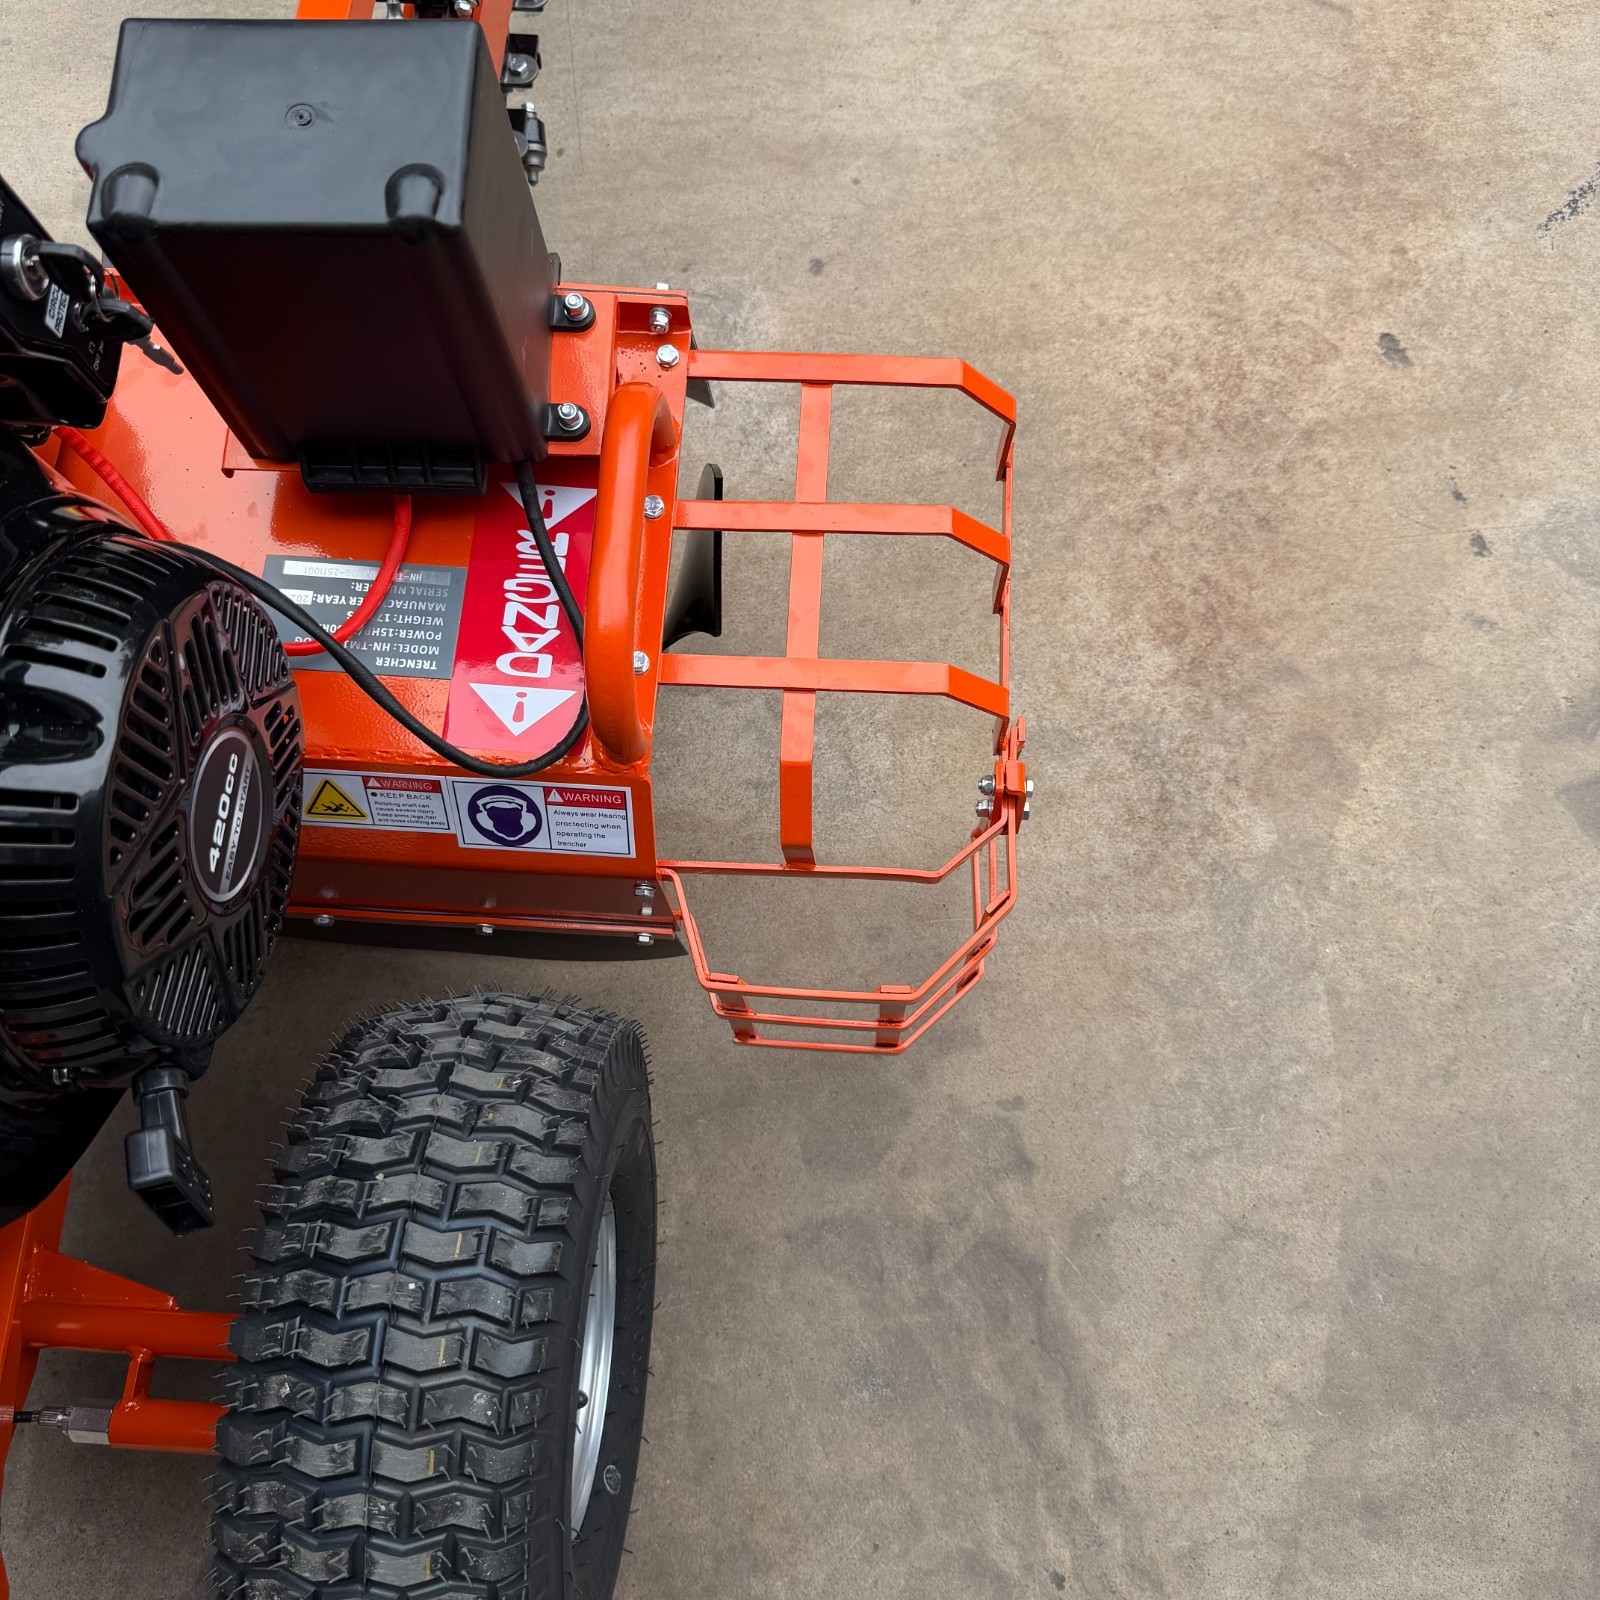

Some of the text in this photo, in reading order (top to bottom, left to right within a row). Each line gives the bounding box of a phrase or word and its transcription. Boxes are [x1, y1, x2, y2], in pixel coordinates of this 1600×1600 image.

[409, 585, 449, 598] SERIAL
[312, 593, 346, 605] YEAR:
[495, 528, 570, 679] DANGER
[393, 613, 444, 626] WEIGHT:
[392, 642, 440, 656] MODEL:
[375, 656, 437, 670] TRENCHER
[381, 779, 433, 791] WARNING
[406, 793, 433, 801] BACK
[563, 792, 622, 804] WARNING
[374, 800, 401, 808] Rotating
[209, 753, 238, 872] 420cc
[225, 764, 253, 882] EASY TO START
[555, 820, 599, 829] proctecting
[556, 831, 593, 839] operating
[557, 840, 587, 848] trencher
